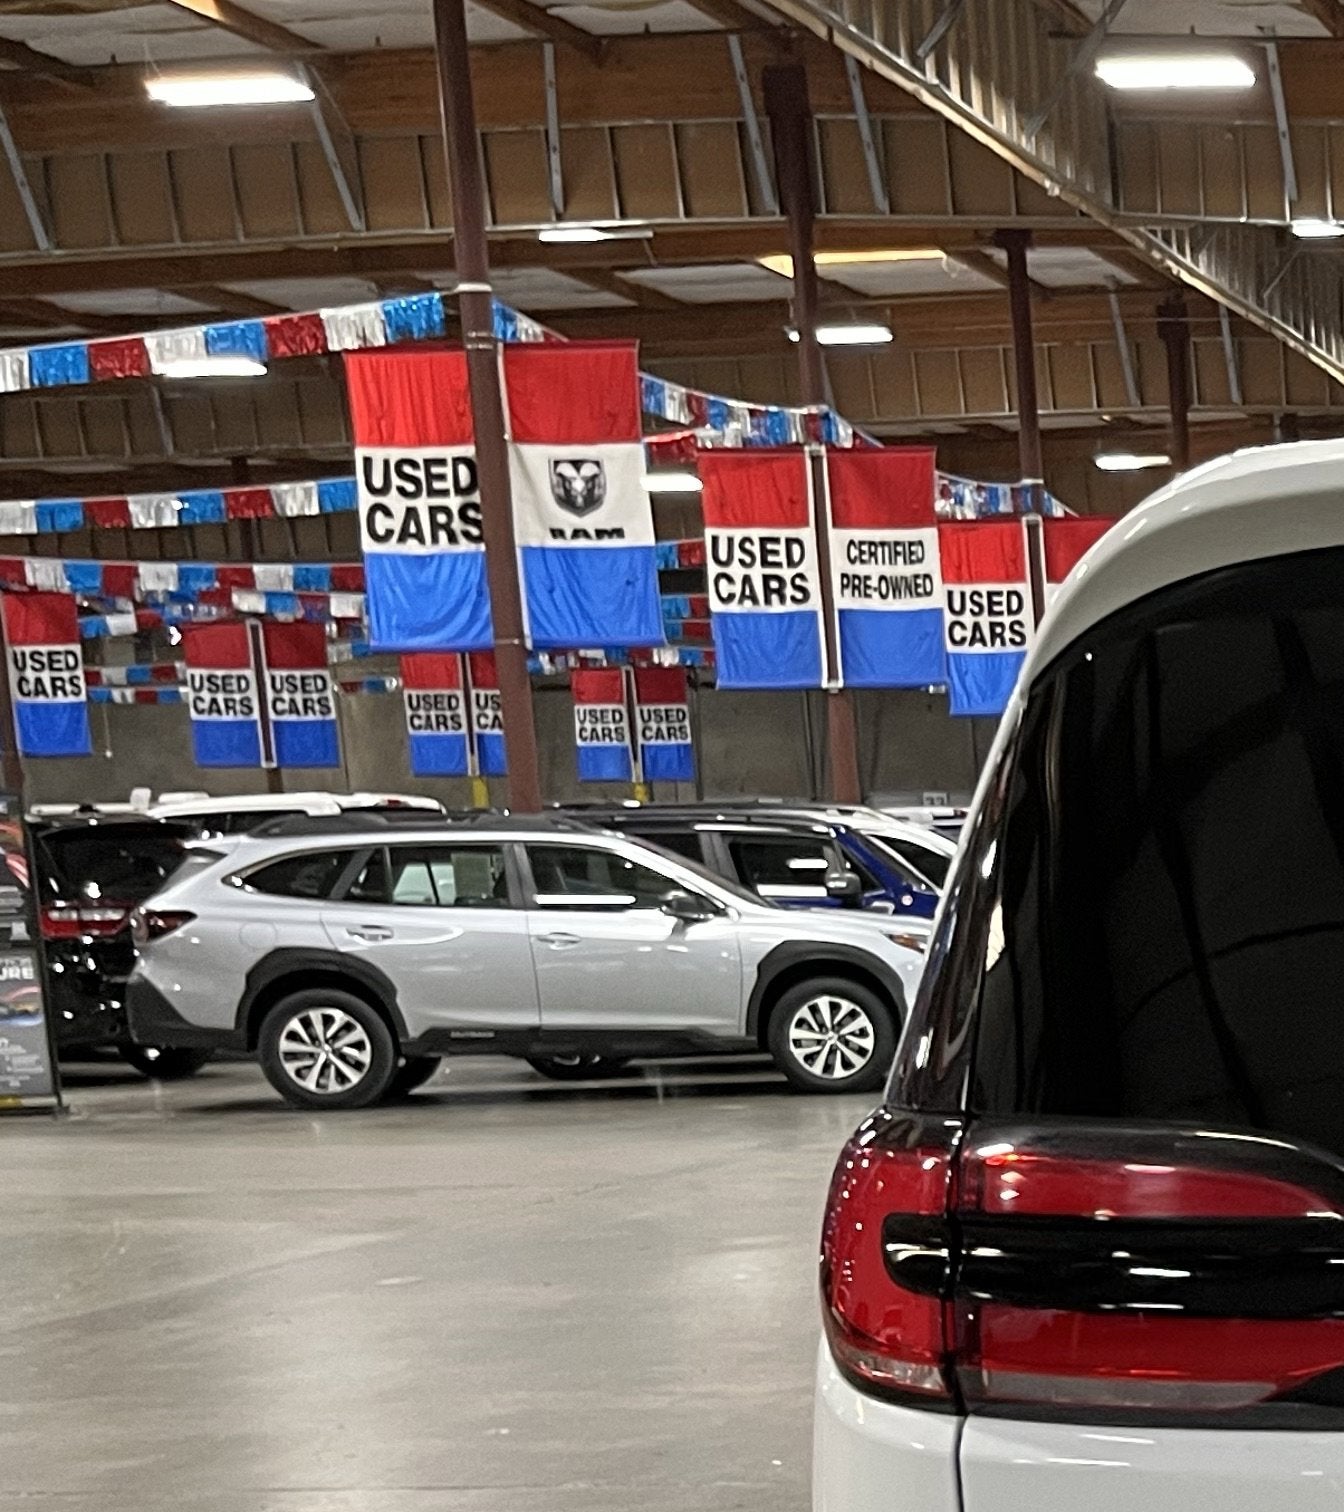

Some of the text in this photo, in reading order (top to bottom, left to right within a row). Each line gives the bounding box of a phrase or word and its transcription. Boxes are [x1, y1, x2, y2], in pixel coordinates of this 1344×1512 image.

[362, 455, 479, 499] USED
[366, 502, 484, 546] CARS
[549, 526, 625, 540] RAM
[711, 536, 806, 569] USED
[846, 539, 925, 566] CERTIFIED
[713, 572, 811, 607] CARS
[840, 573, 934, 600] PRE-OWNED
[947, 589, 1024, 617] USED
[948, 620, 1027, 648] CARS
[13, 649, 79, 674] USED
[17, 675, 83, 699] CARS
[190, 673, 250, 695] USED
[270, 674, 328, 695] USED
[193, 696, 254, 717] CARS
[272, 696, 332, 717] CARS
[407, 693, 460, 711] USED
[475, 693, 500, 710] US
[409, 713, 462, 731] CARS
[477, 712, 503, 730] CA
[577, 708, 624, 724] USED
[640, 708, 686, 724] USED
[579, 726, 625, 742] CARS
[642, 725, 689, 741] CARS
